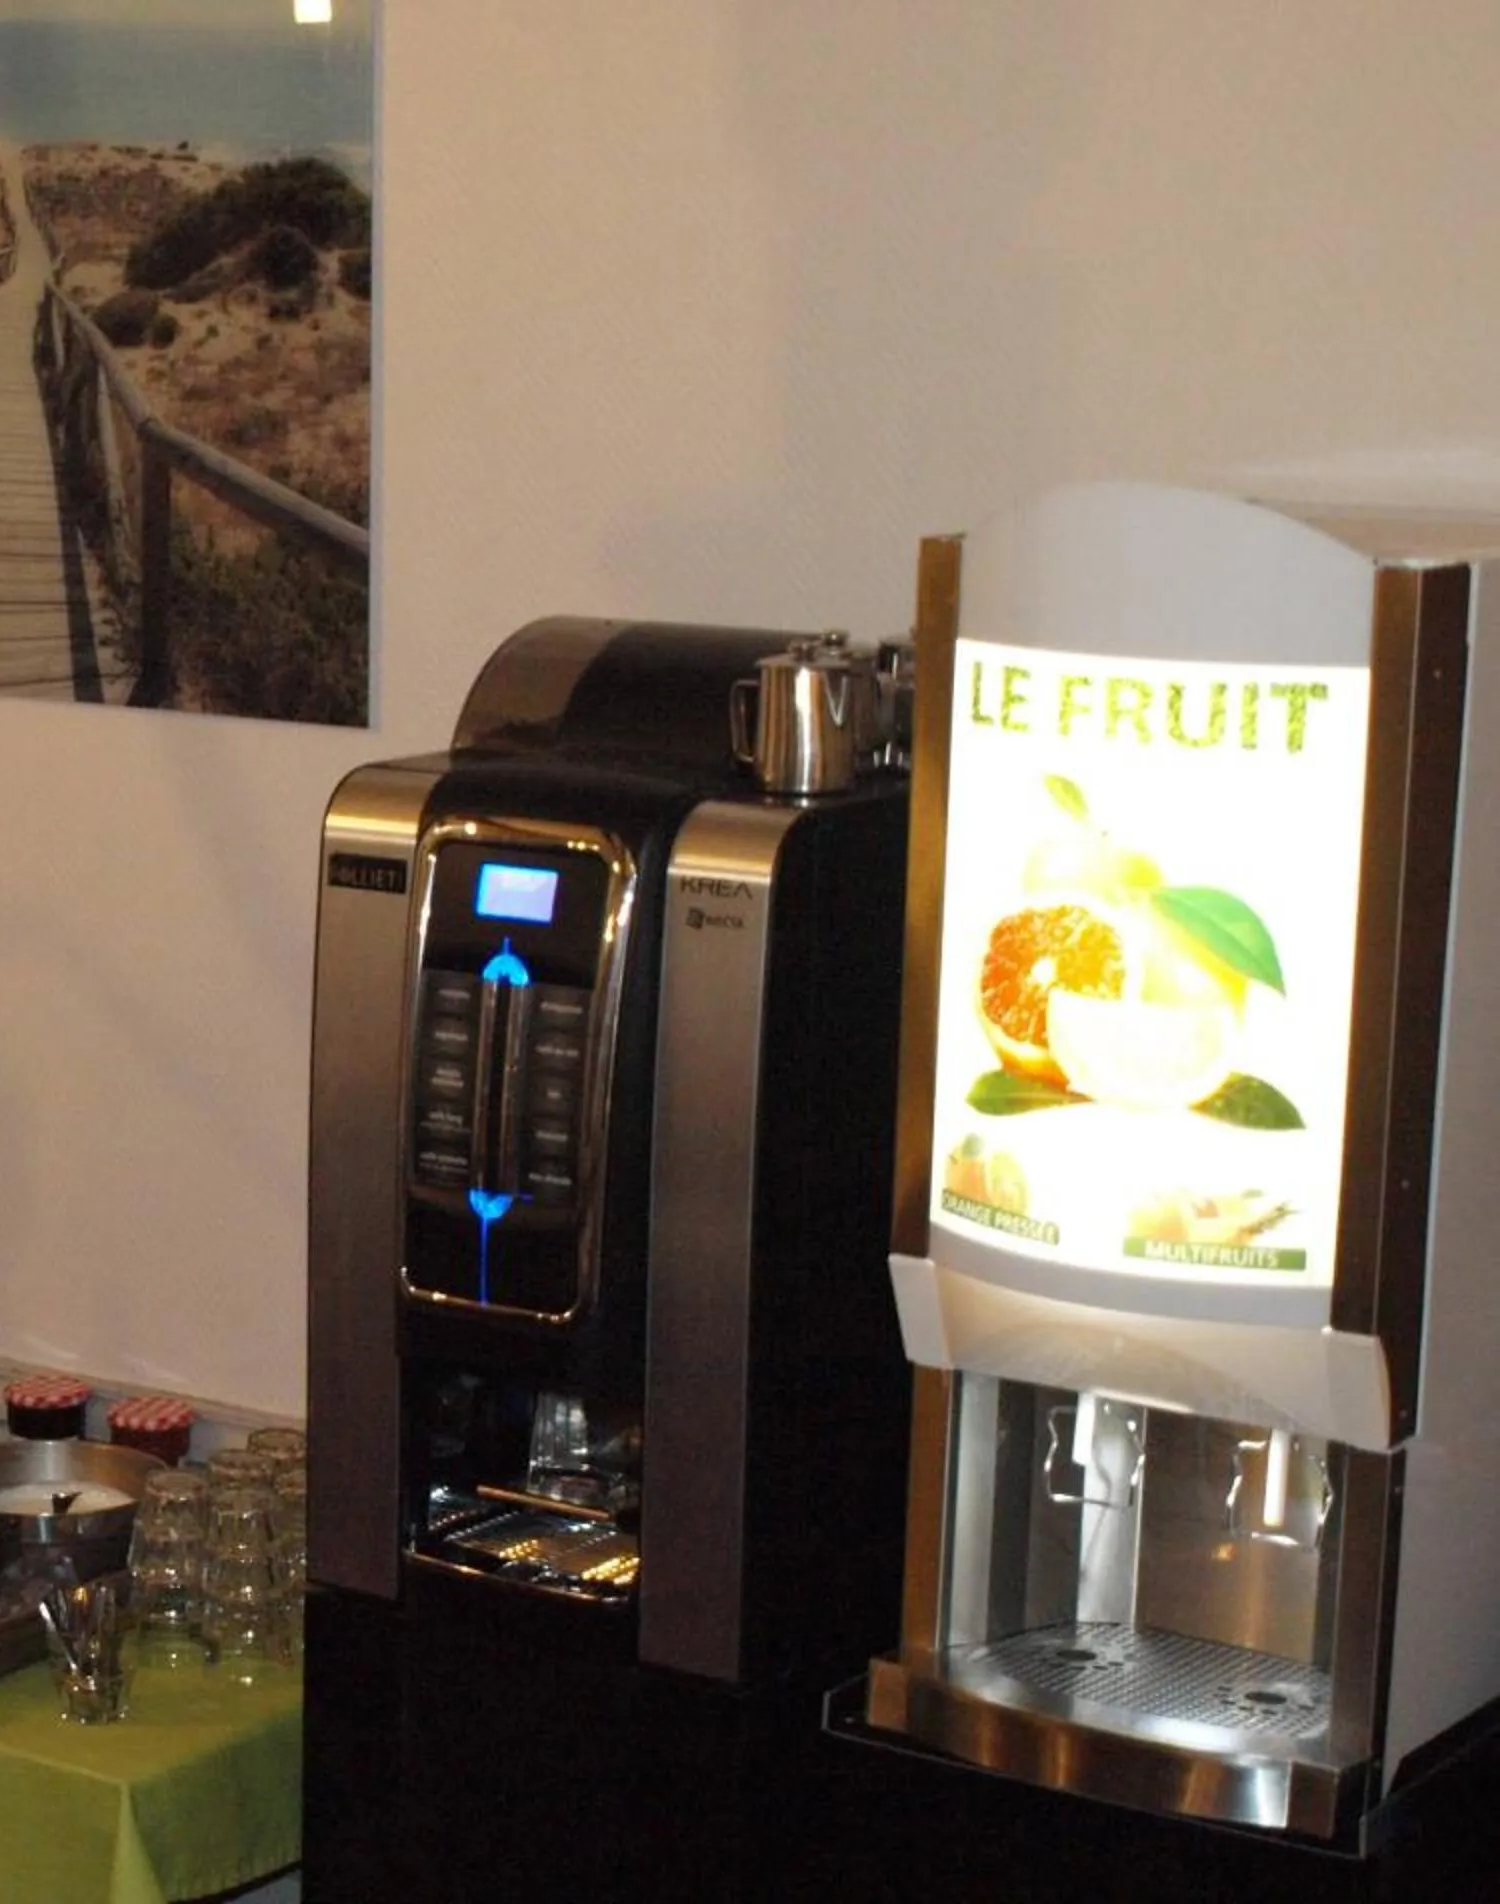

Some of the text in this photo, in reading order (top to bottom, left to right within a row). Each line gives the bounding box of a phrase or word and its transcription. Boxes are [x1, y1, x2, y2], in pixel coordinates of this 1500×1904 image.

[970, 660, 1329, 753] LE FRUIT
[1144, 1239, 1279, 1268] MULTIFRUITS
